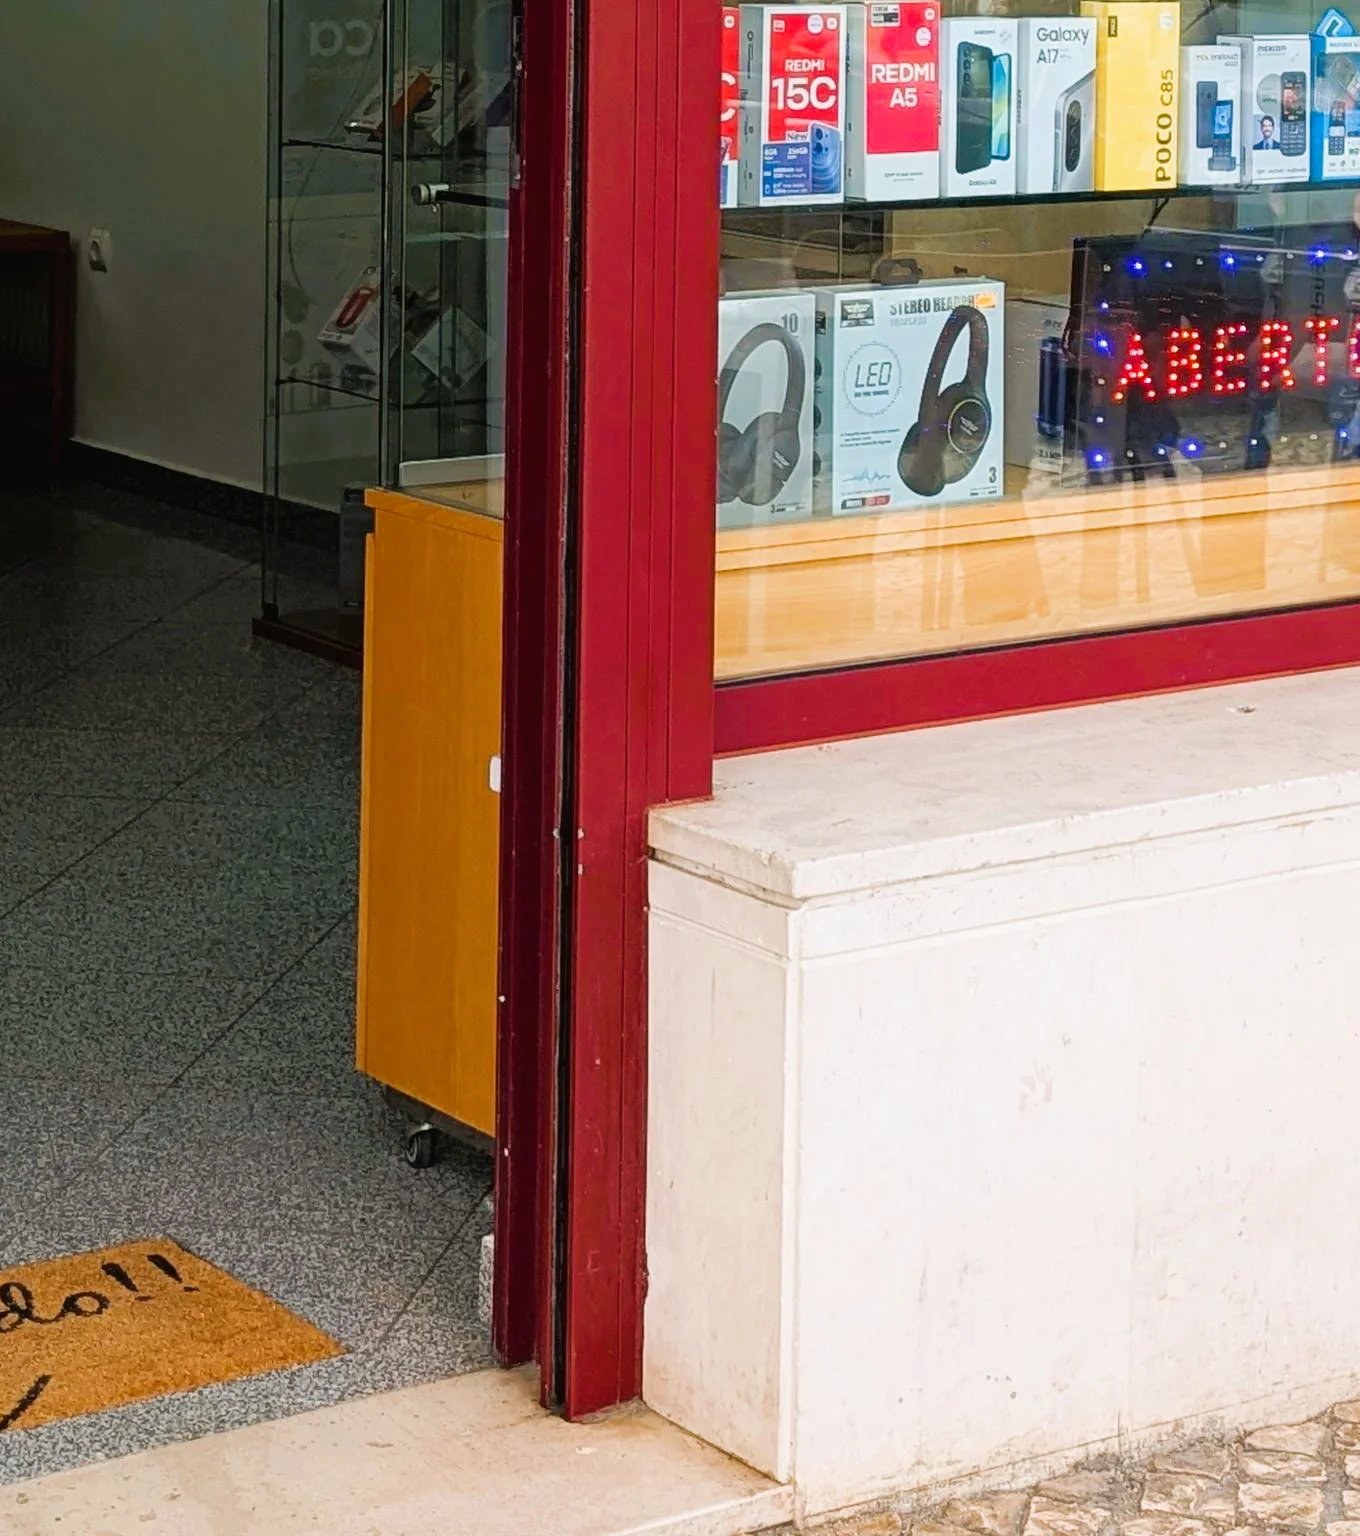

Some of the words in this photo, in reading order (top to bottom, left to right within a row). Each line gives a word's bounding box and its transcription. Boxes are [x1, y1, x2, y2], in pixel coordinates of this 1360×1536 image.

[1037, 28, 1089, 45] Galaxy
[784, 58, 826, 72] REDMI
[1037, 49, 1059, 64] A17
[871, 63, 936, 83] REDMI
[771, 76, 837, 111] 15C
[890, 88, 918, 108] A5
[1160, 69, 1174, 107] C85
[1155, 113, 1173, 182] POCO
[890, 298, 931, 315] STEREO
[855, 361, 892, 388] LED
